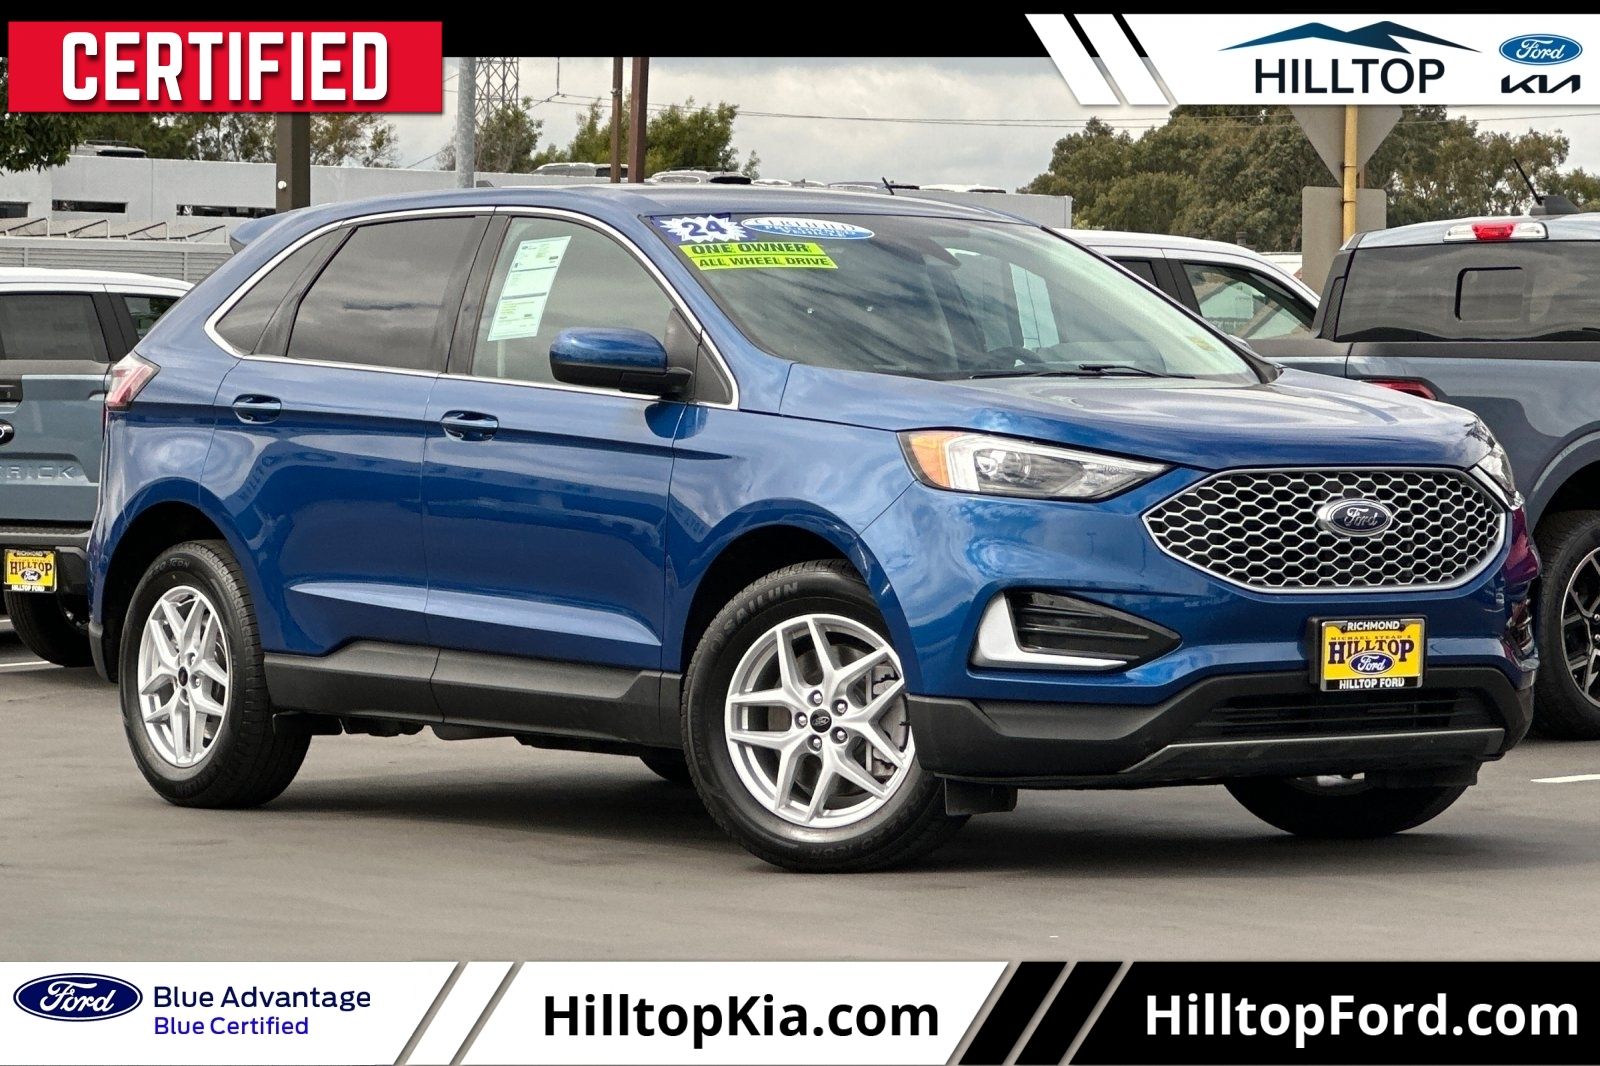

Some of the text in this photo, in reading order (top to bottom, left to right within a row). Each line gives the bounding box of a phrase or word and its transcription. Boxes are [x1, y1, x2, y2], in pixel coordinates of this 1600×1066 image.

[682, 220, 728, 237] 24
[691, 243, 809, 255] ONE OWNER
[699, 256, 831, 267] ALL WHEEL DRIVE
[0, 465, 75, 479] RICK
[1343, 507, 1379, 527] Ford
[10, 561, 52, 576] HILLTOP
[1347, 620, 1400, 631] RICHMOND
[1328, 640, 1414, 664] HILLTOP
[1357, 654, 1386, 672] Ford
[1339, 677, 1405, 689] HILLTOP FORD
